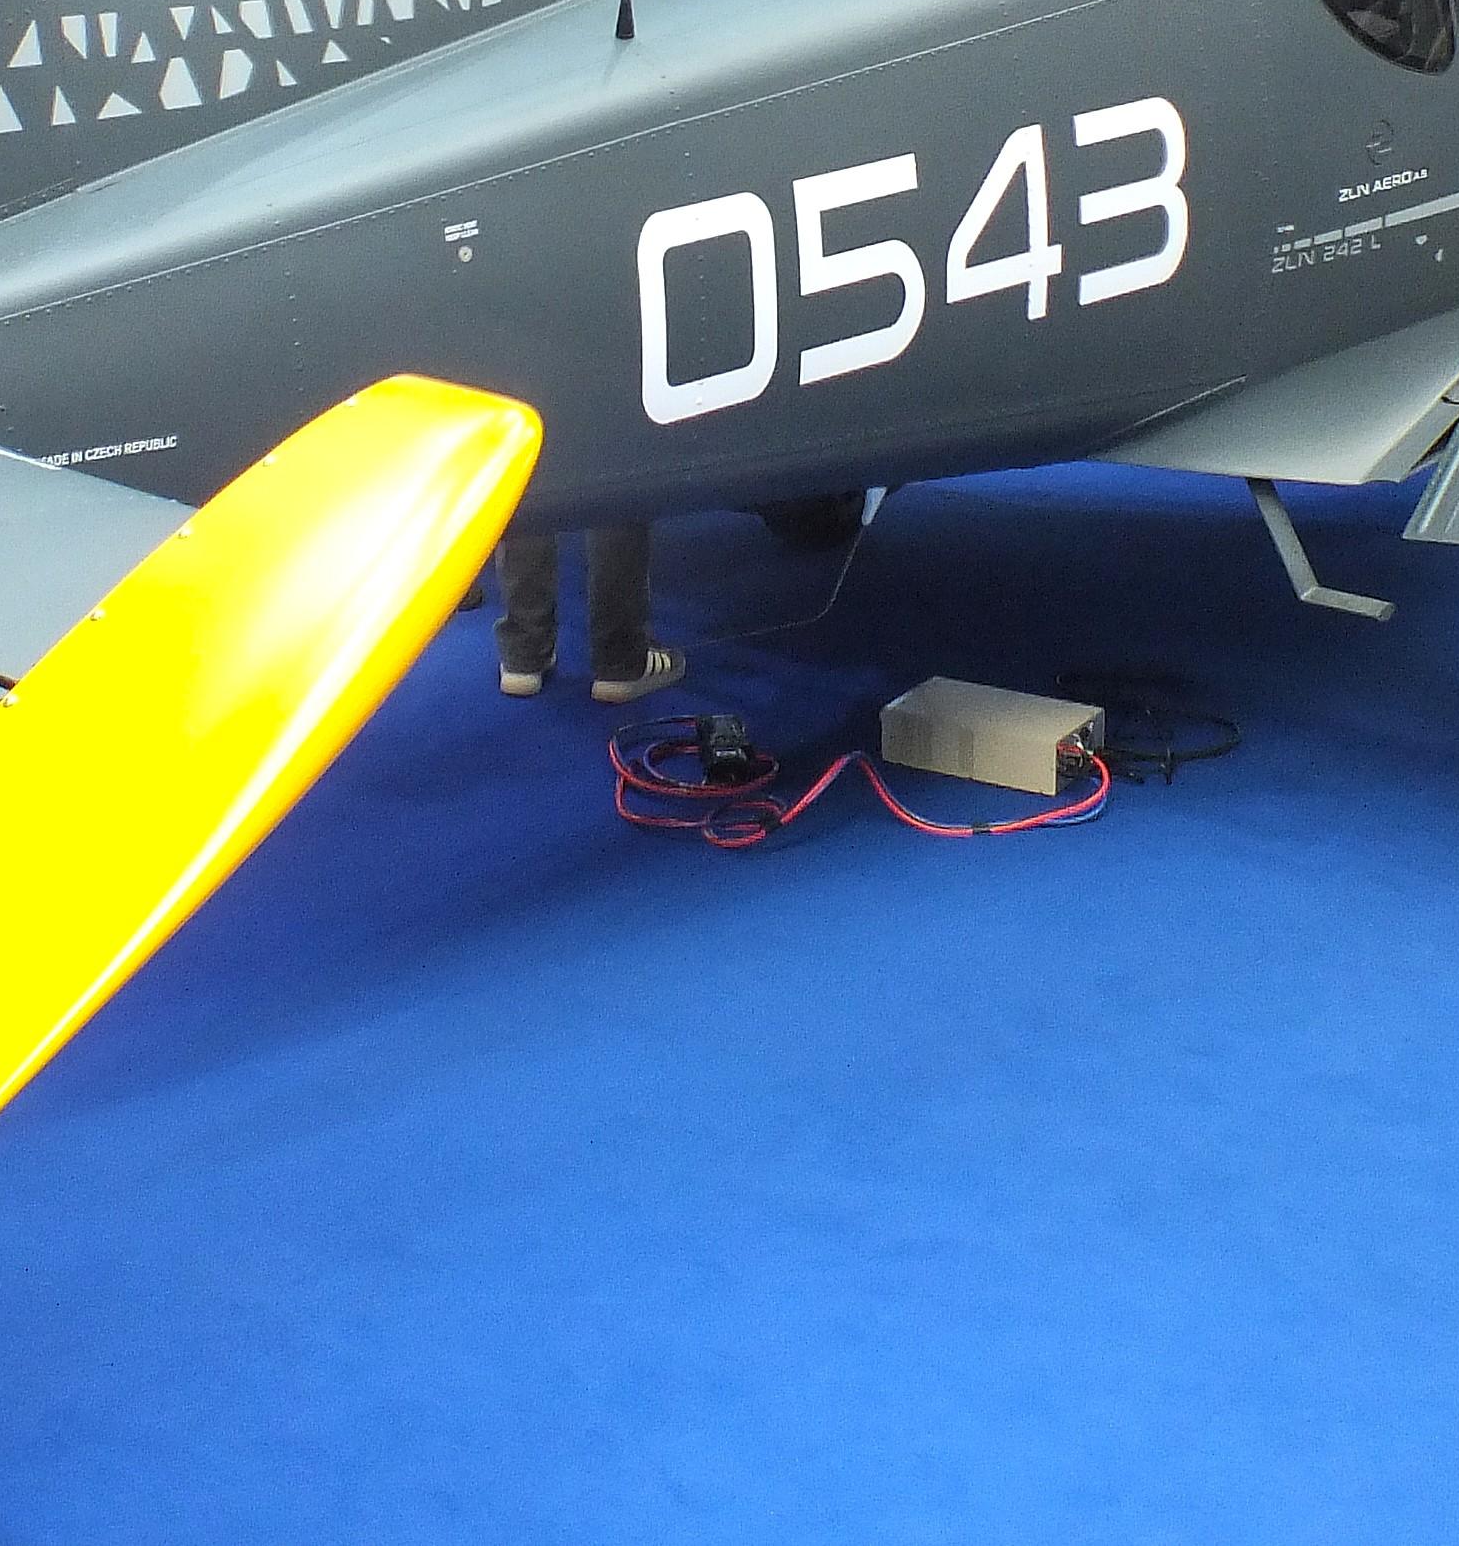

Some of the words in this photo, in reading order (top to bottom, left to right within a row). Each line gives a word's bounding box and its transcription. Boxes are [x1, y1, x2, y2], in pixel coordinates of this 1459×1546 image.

[1372, 171, 1414, 192] AERO
[637, 96, 1189, 425] 0543
[1272, 251, 1315, 274] ZLIN
[1323, 238, 1362, 262] 242
[1371, 235, 1382, 250] L
[71, 450, 83, 463] IN
[85, 443, 123, 461] CZECH
[124, 436, 178, 455] REPUBLIC
